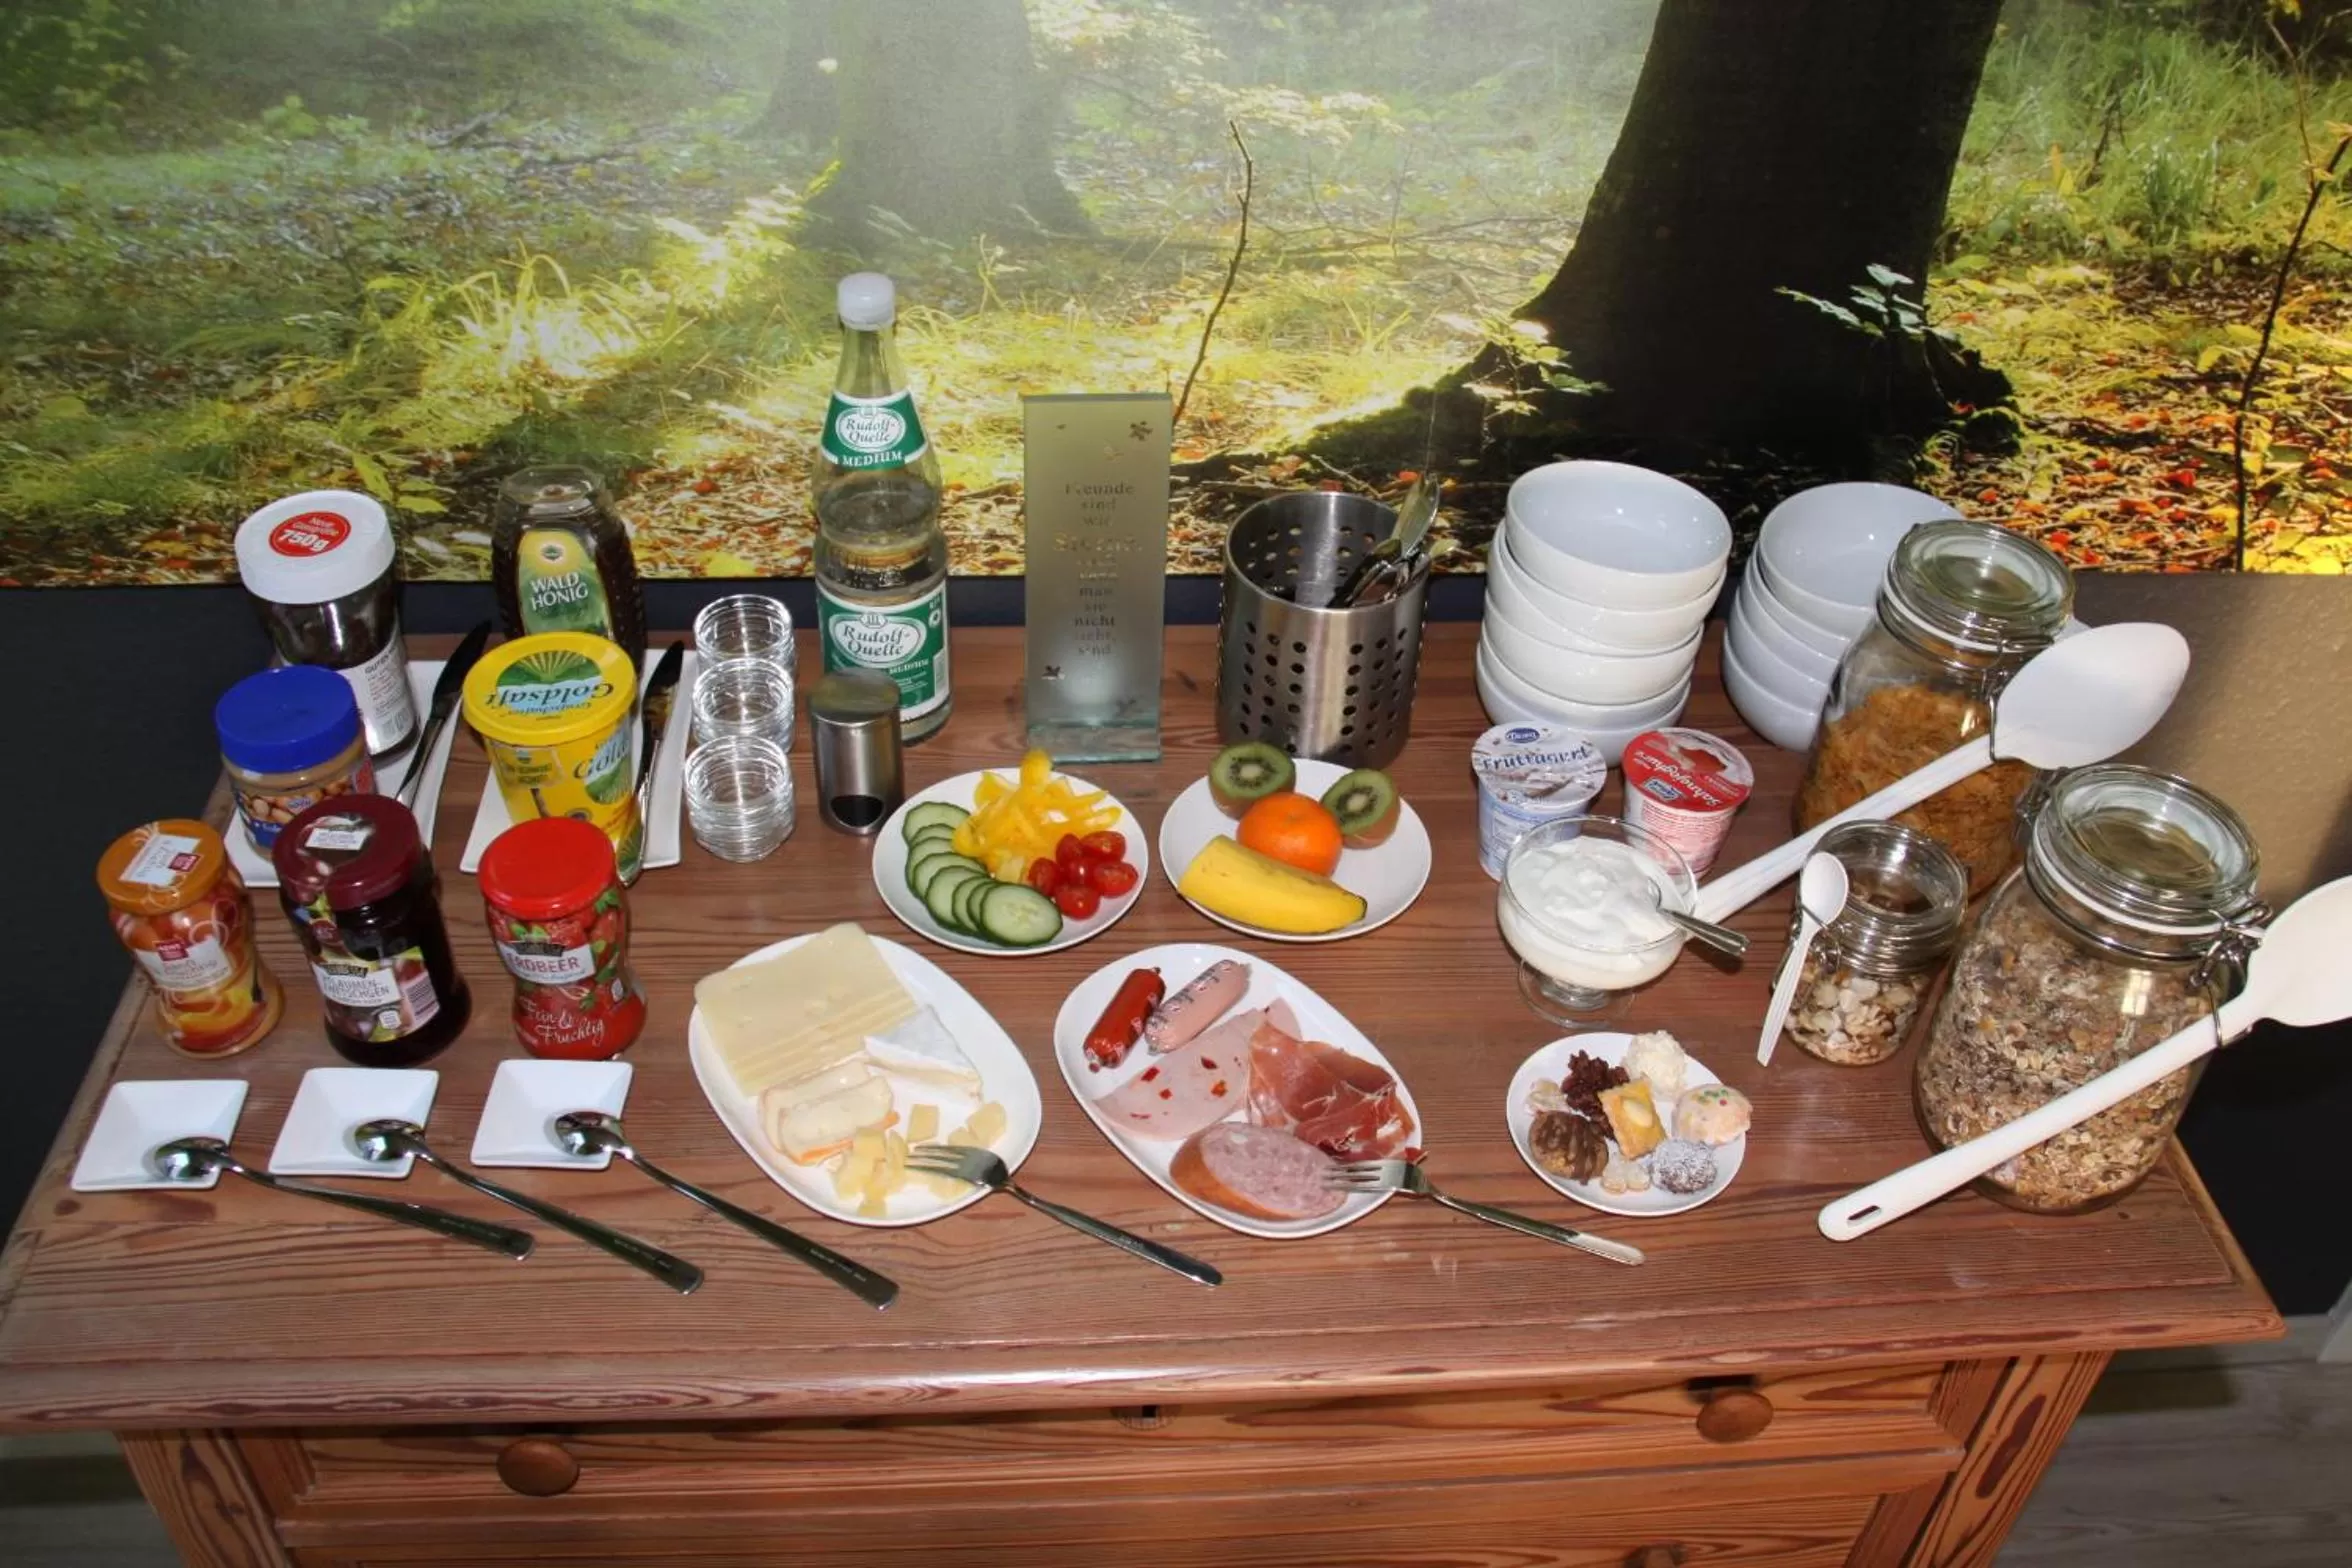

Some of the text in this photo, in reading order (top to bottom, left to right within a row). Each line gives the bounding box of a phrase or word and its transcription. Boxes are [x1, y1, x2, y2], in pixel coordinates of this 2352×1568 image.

[841, 450, 903, 467] MEDIUM
[277, 529, 331, 553] 750g
[530, 571, 580, 594] WALD
[530, 582, 589, 612] HONIG
[843, 623, 910, 645] Rudolf-
[847, 639, 904, 657] Quelle
[485, 682, 615, 708] Goldsaft
[505, 952, 580, 974] ERDBEER
[534, 1017, 605, 1048] Fruchtig
